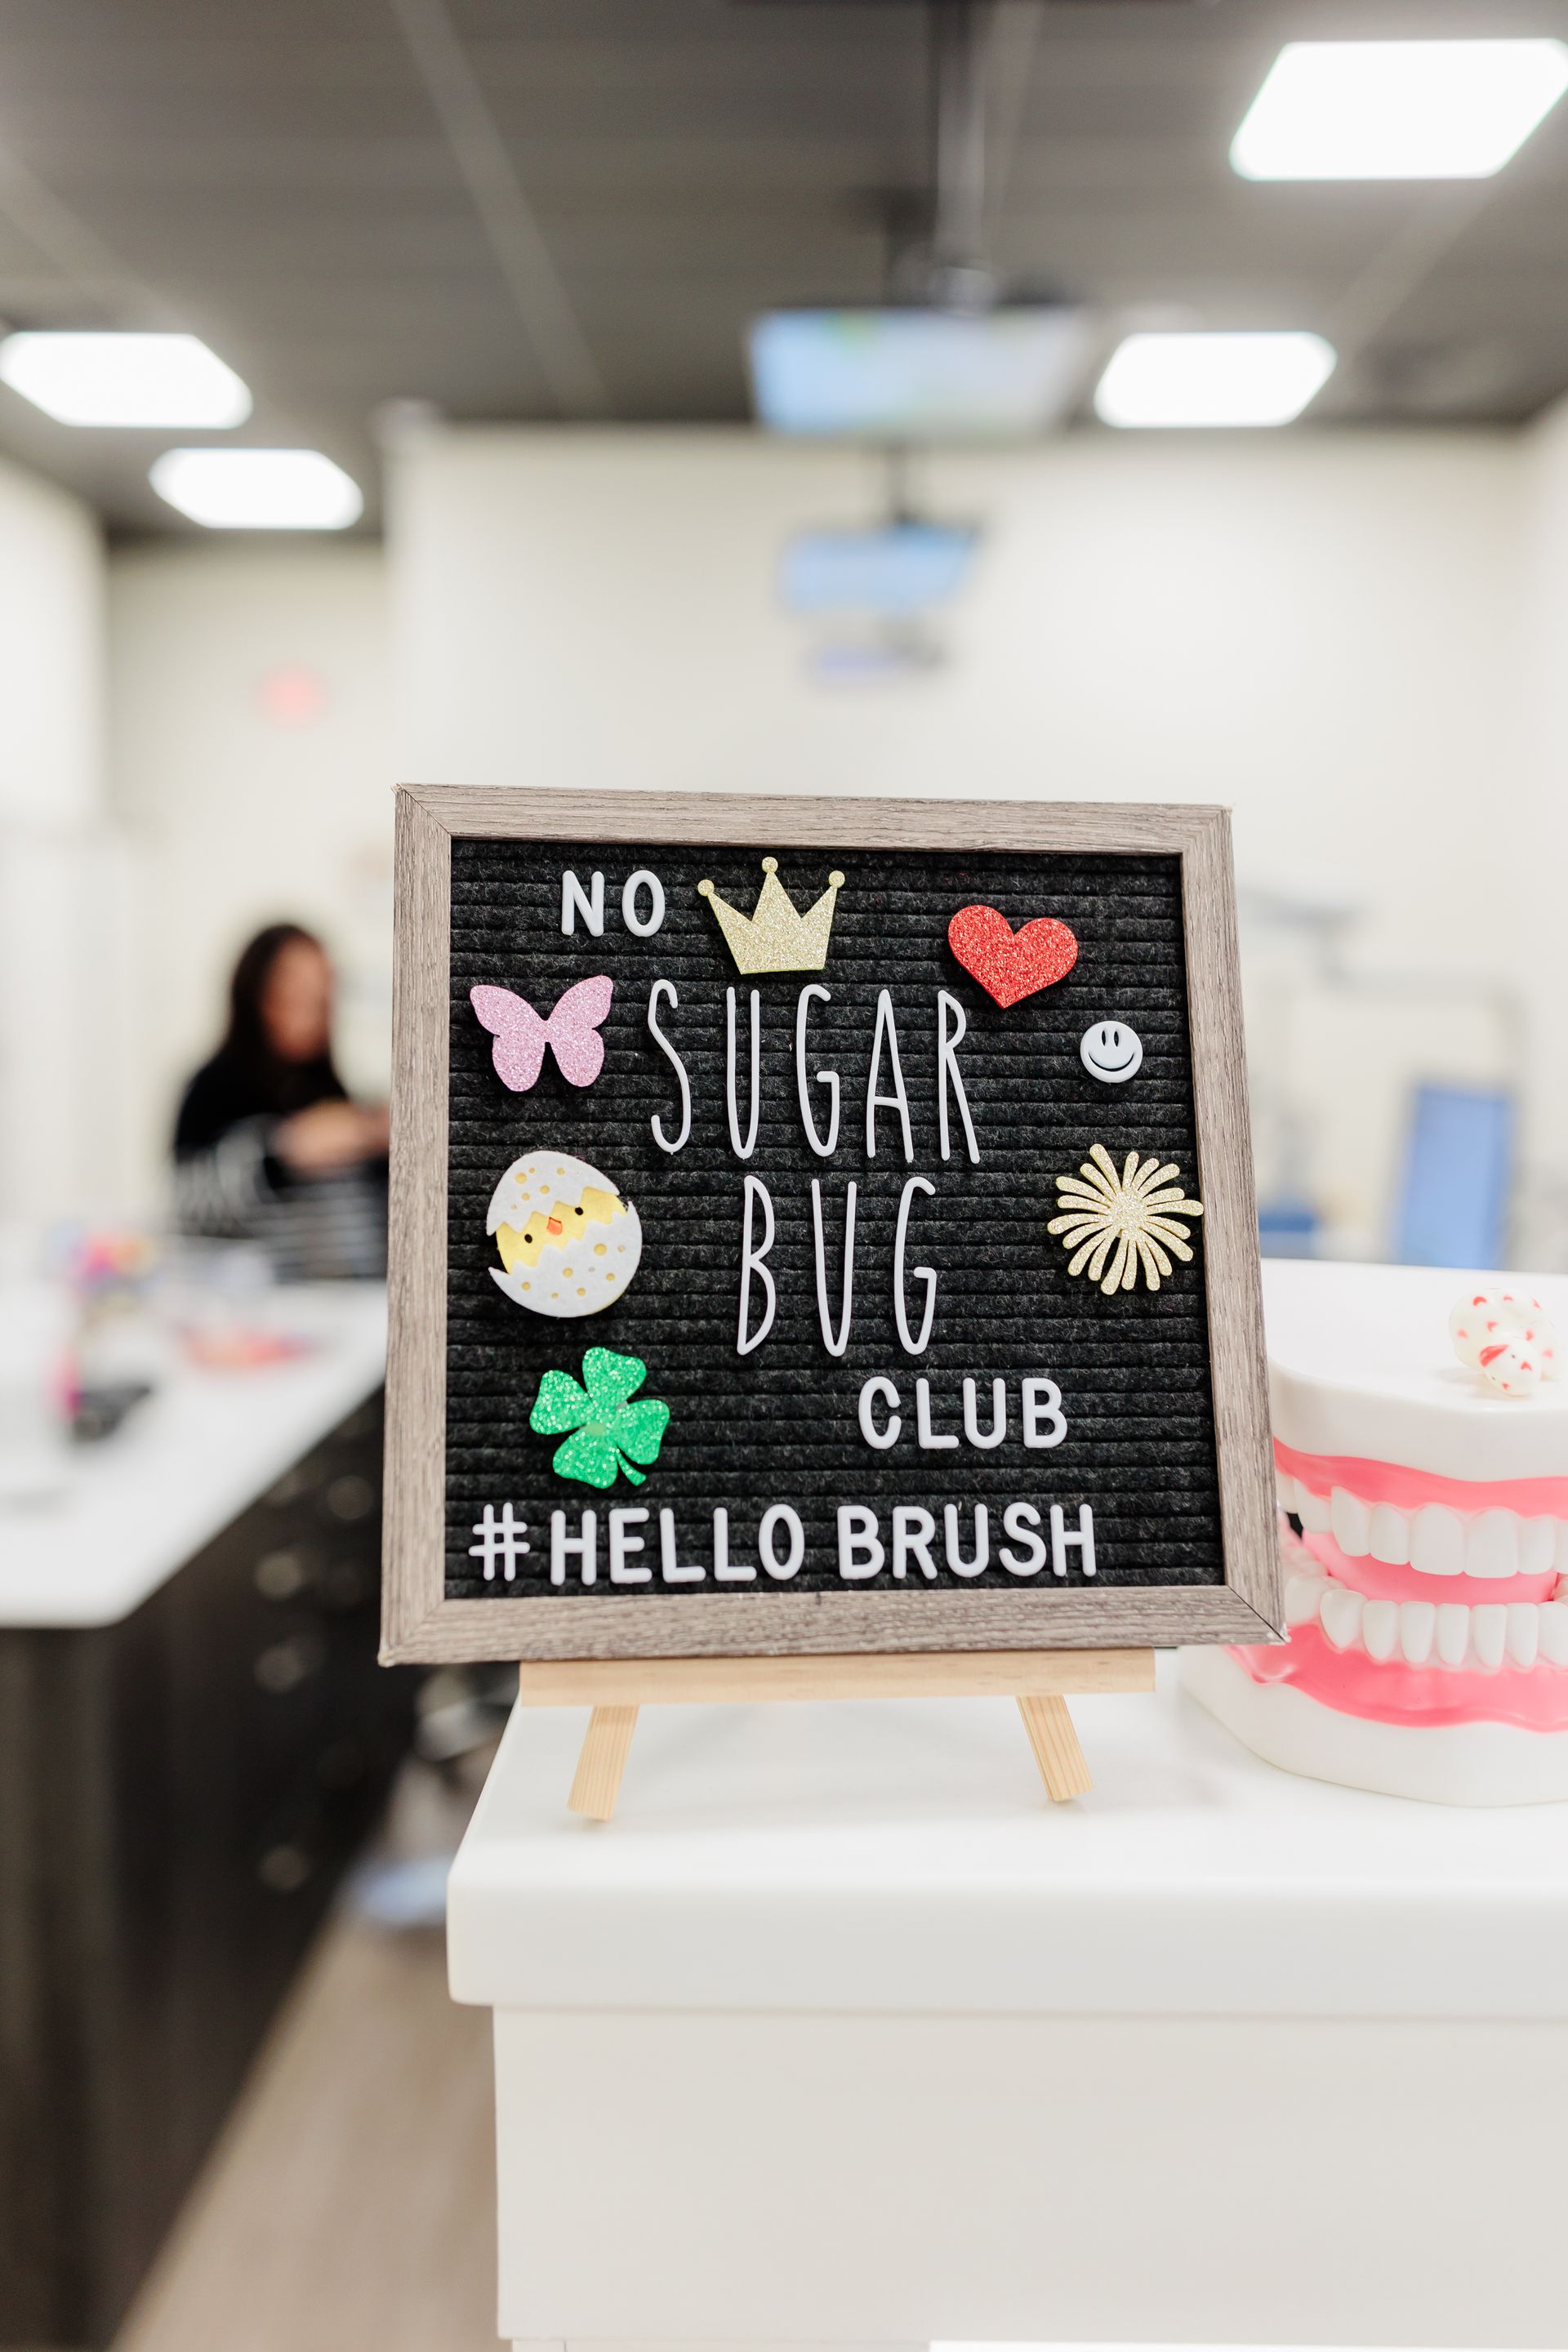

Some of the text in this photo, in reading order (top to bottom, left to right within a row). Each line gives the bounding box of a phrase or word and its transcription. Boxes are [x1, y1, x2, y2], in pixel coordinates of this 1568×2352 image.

[560, 868, 666, 938] NO
[646, 978, 982, 1165] SUGAR
[736, 1174, 938, 1358] BUG
[858, 1375, 1069, 1450] CLUB
[468, 1501, 1098, 1587] #HELLO BRUSH
